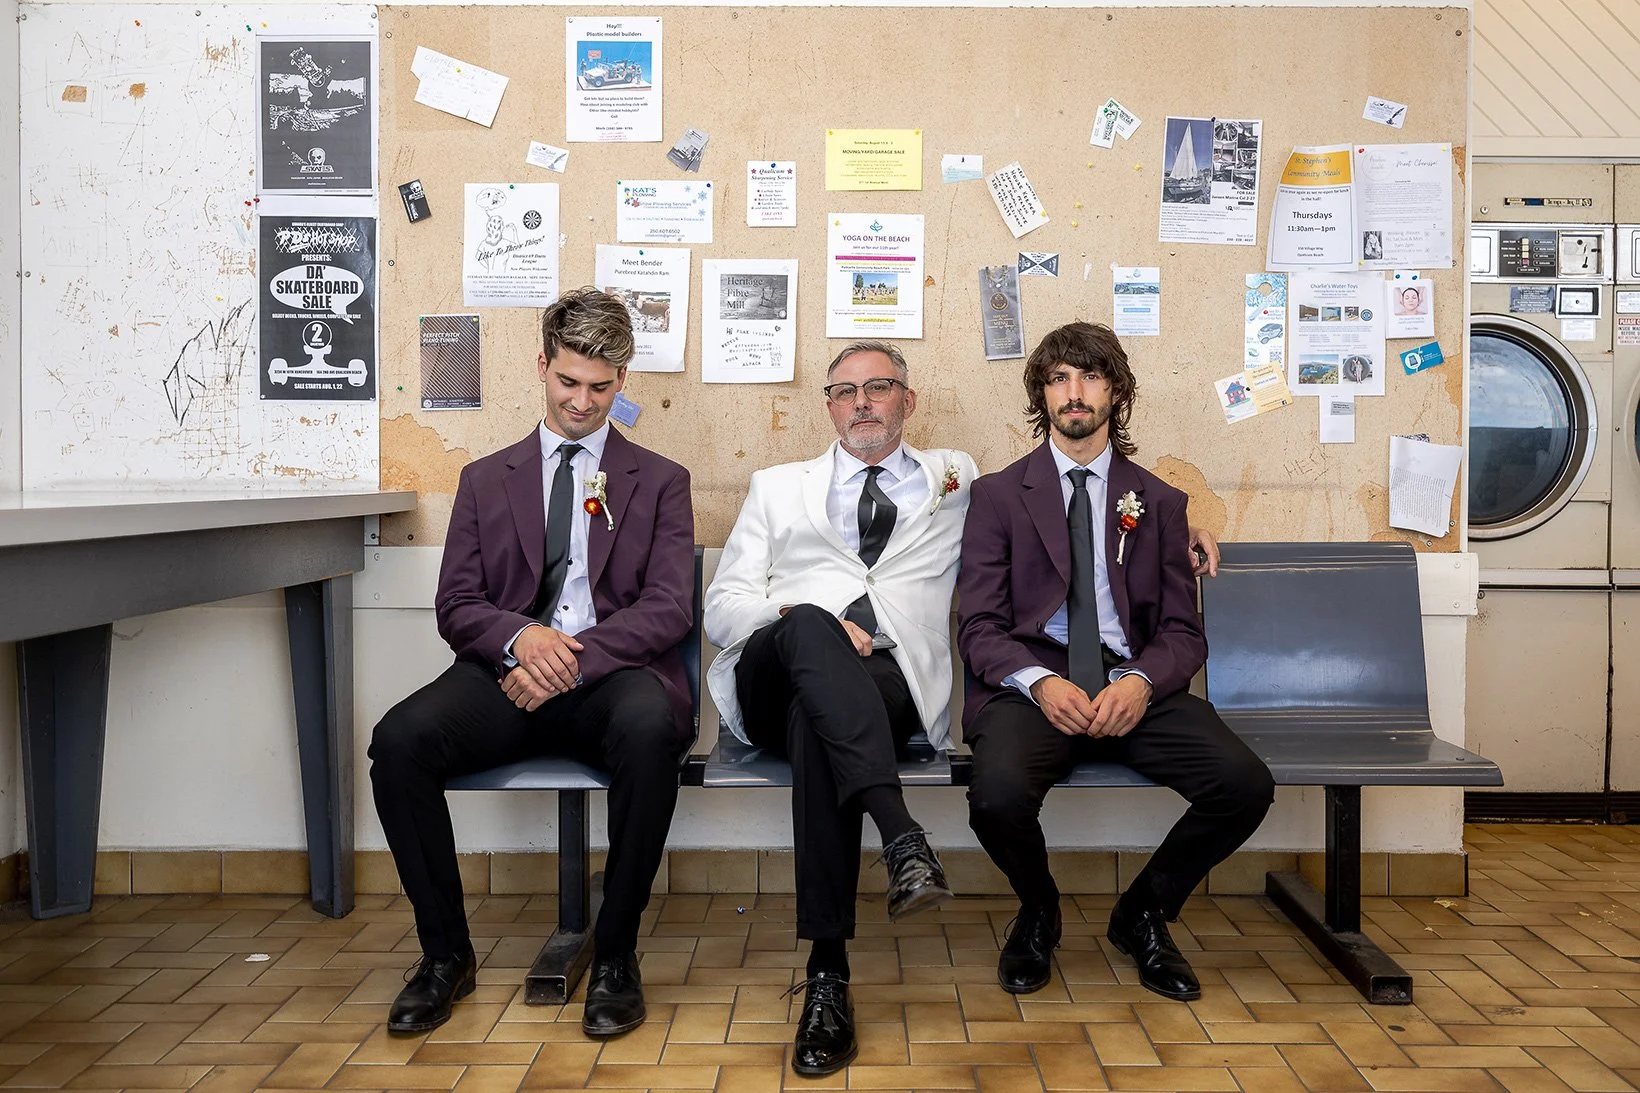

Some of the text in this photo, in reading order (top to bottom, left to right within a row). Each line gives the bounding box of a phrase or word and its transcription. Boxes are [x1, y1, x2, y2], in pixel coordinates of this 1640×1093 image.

[306, 266, 326, 279] DA'
[276, 281, 359, 294] SKATEBOARD
[727, 277, 762, 286] Heritage
[303, 295, 332, 308] SALE
[312, 323, 322, 342] 2
